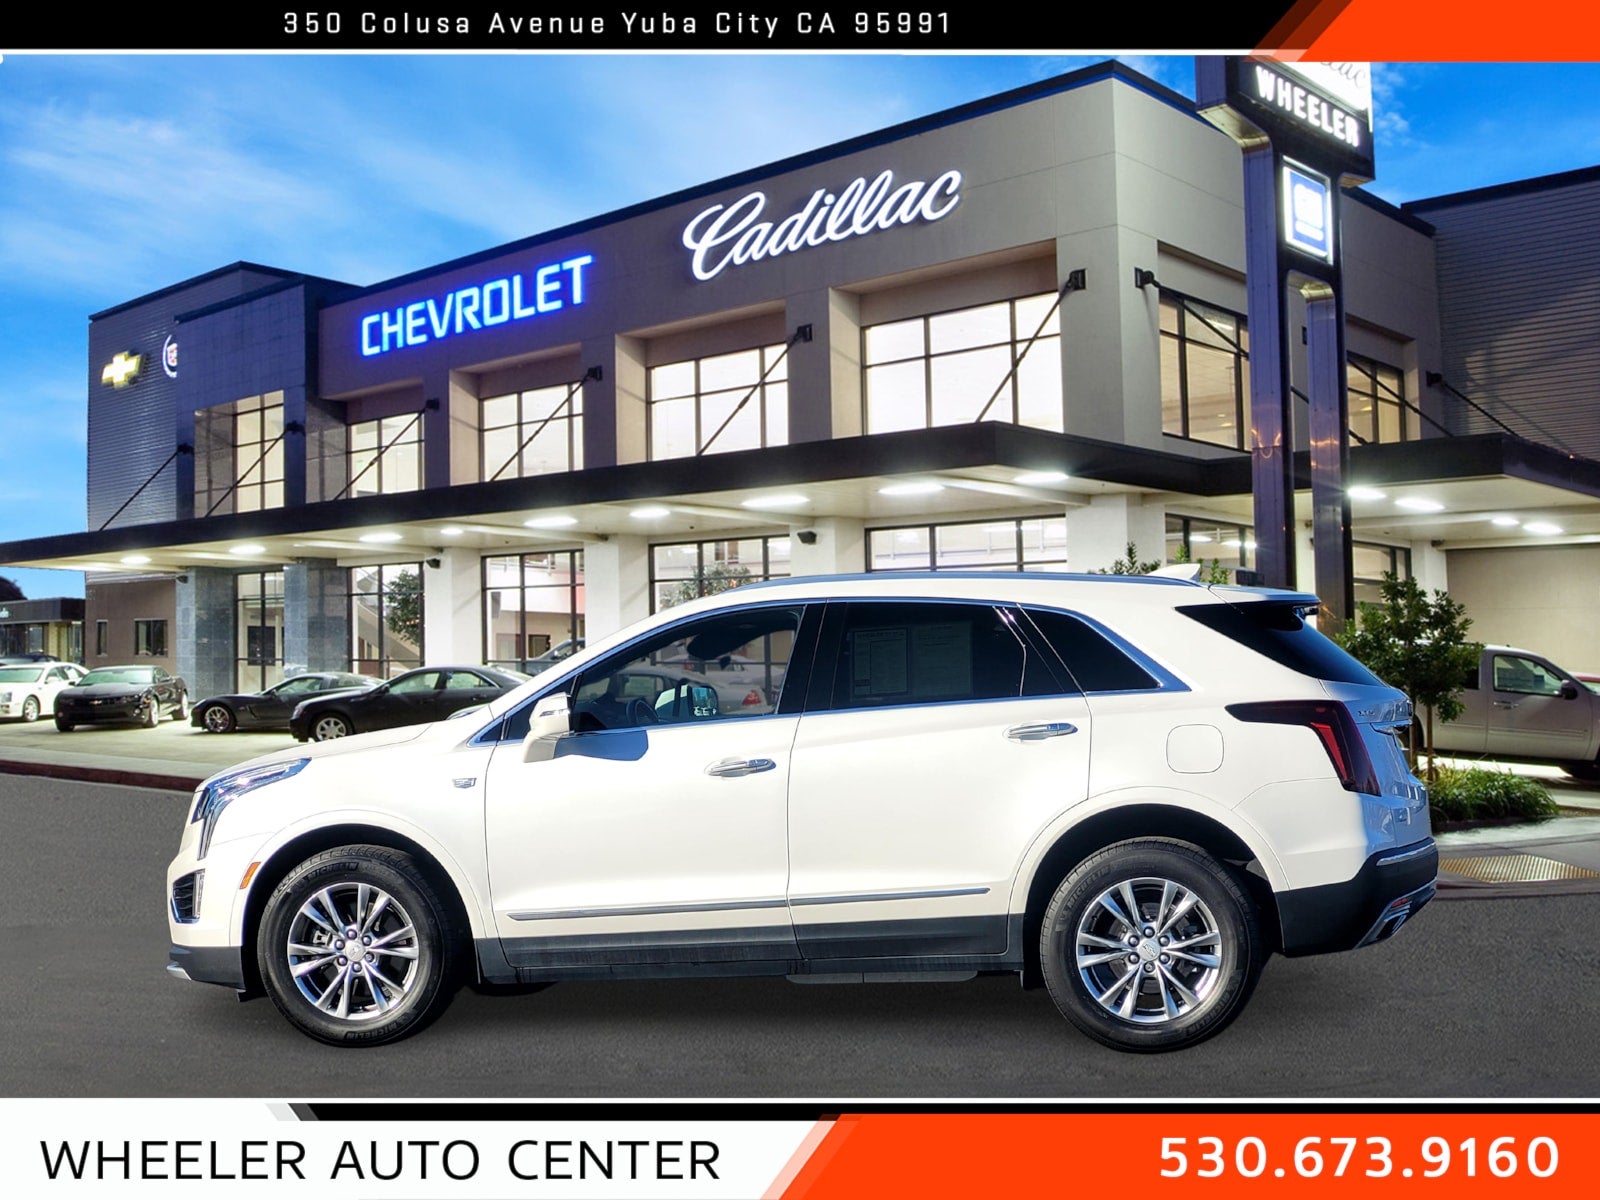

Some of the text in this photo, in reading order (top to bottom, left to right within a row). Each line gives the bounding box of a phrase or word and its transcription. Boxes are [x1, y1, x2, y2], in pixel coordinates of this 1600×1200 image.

[1255, 65, 1359, 147] WHEELER
[682, 169, 961, 281] Cadillac
[360, 254, 593, 357] CHEVROLET
[308, 862, 358, 881] MICHELIN
